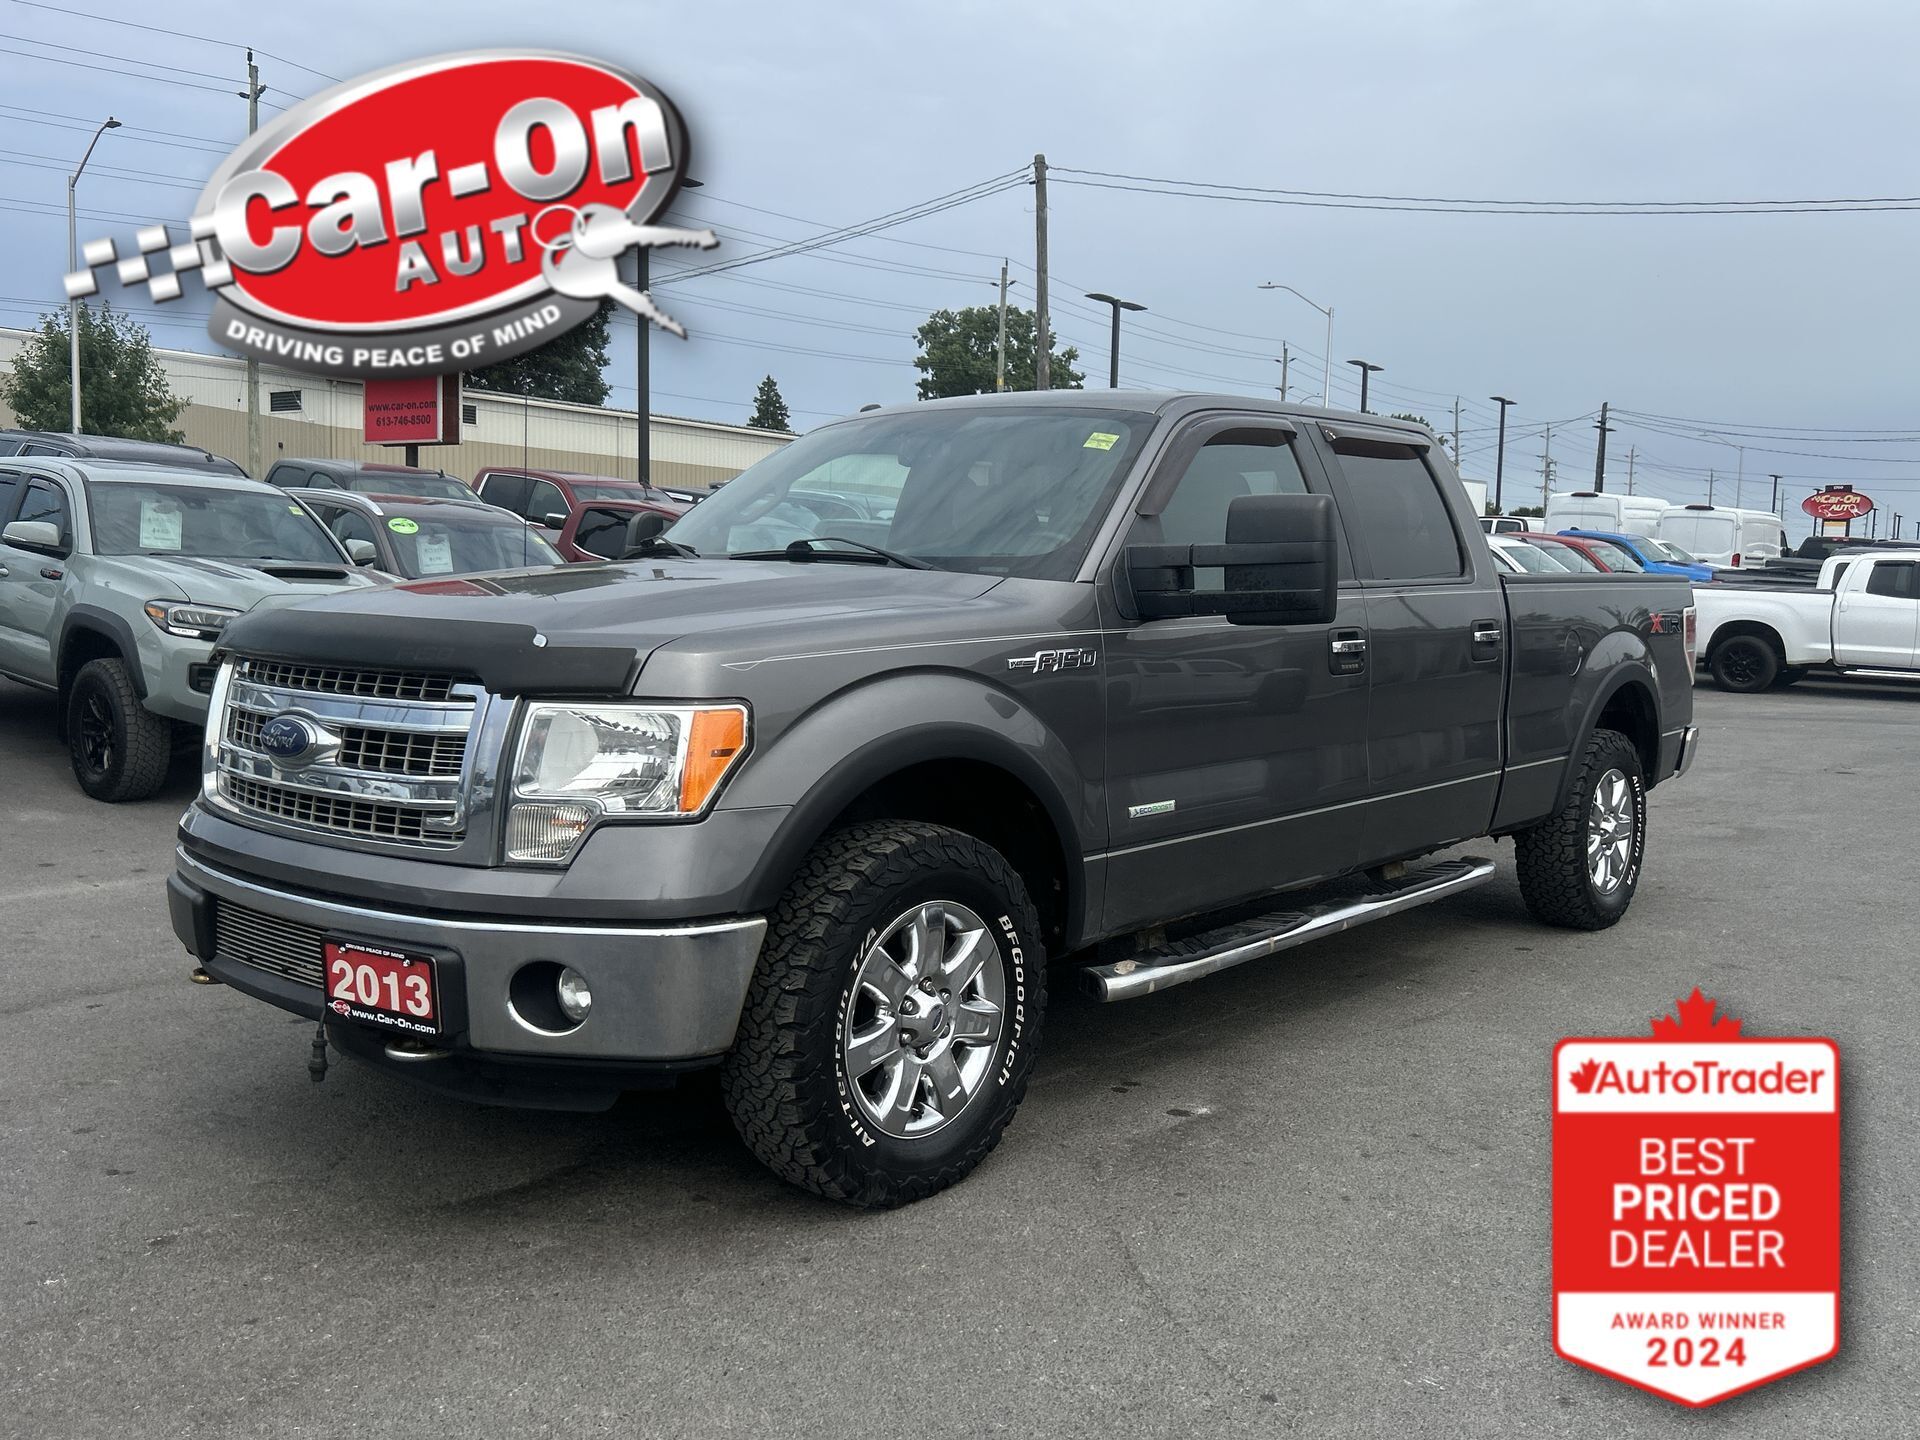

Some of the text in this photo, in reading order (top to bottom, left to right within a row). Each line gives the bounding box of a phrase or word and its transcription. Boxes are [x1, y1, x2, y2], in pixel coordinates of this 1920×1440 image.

[368, 400, 437, 412] www.car-on.com
[376, 415, 431, 427] 613-746-8500
[1822, 494, 1861, 504] Car-On
[1649, 613, 1682, 633] XTR
[262, 723, 298, 748] Ford
[331, 959, 431, 1017] 2013
[997, 914, 1025, 1087] BFGoodrich
[351, 1008, 437, 1035] www.Car-On.com
[835, 927, 877, 1147] All-Terrain T/A
